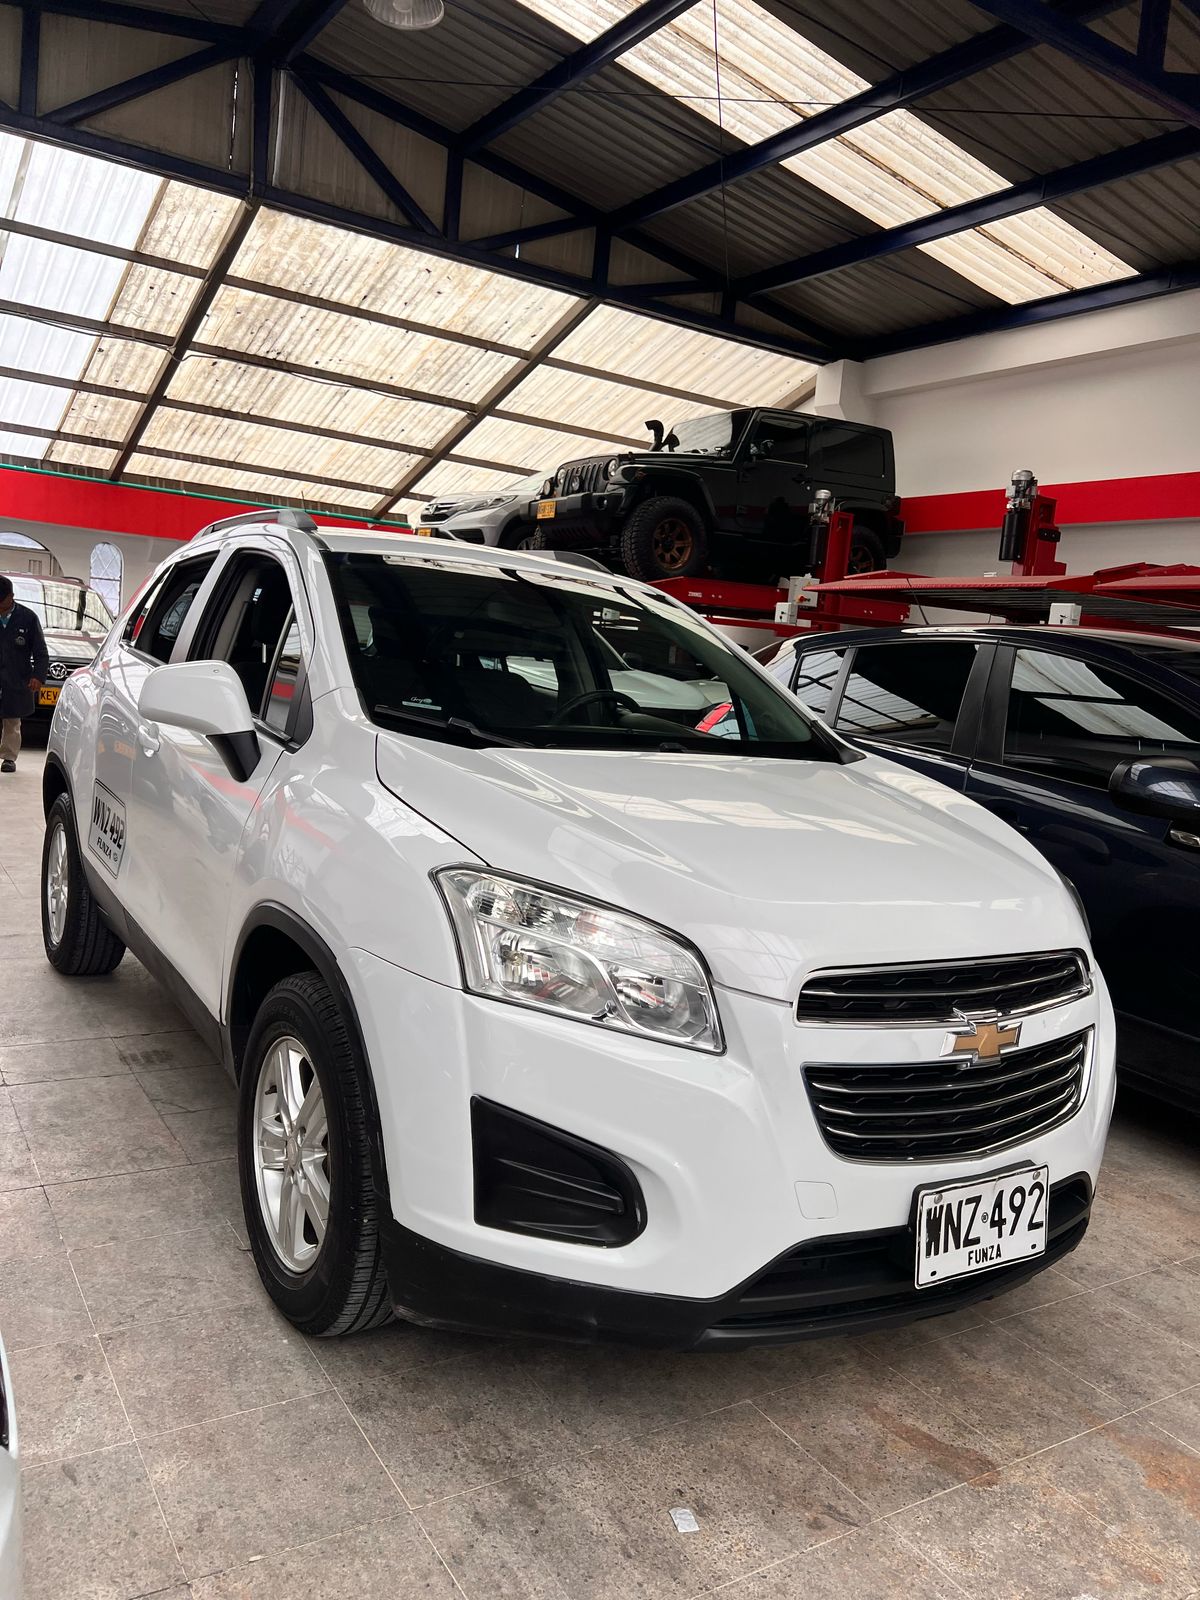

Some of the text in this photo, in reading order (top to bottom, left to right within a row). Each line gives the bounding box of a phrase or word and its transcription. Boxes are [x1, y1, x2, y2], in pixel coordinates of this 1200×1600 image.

[97, 836, 112, 860] FUNZA
[926, 1181, 1044, 1258] WNZ 492
[968, 1244, 1002, 1266] FUNZA
